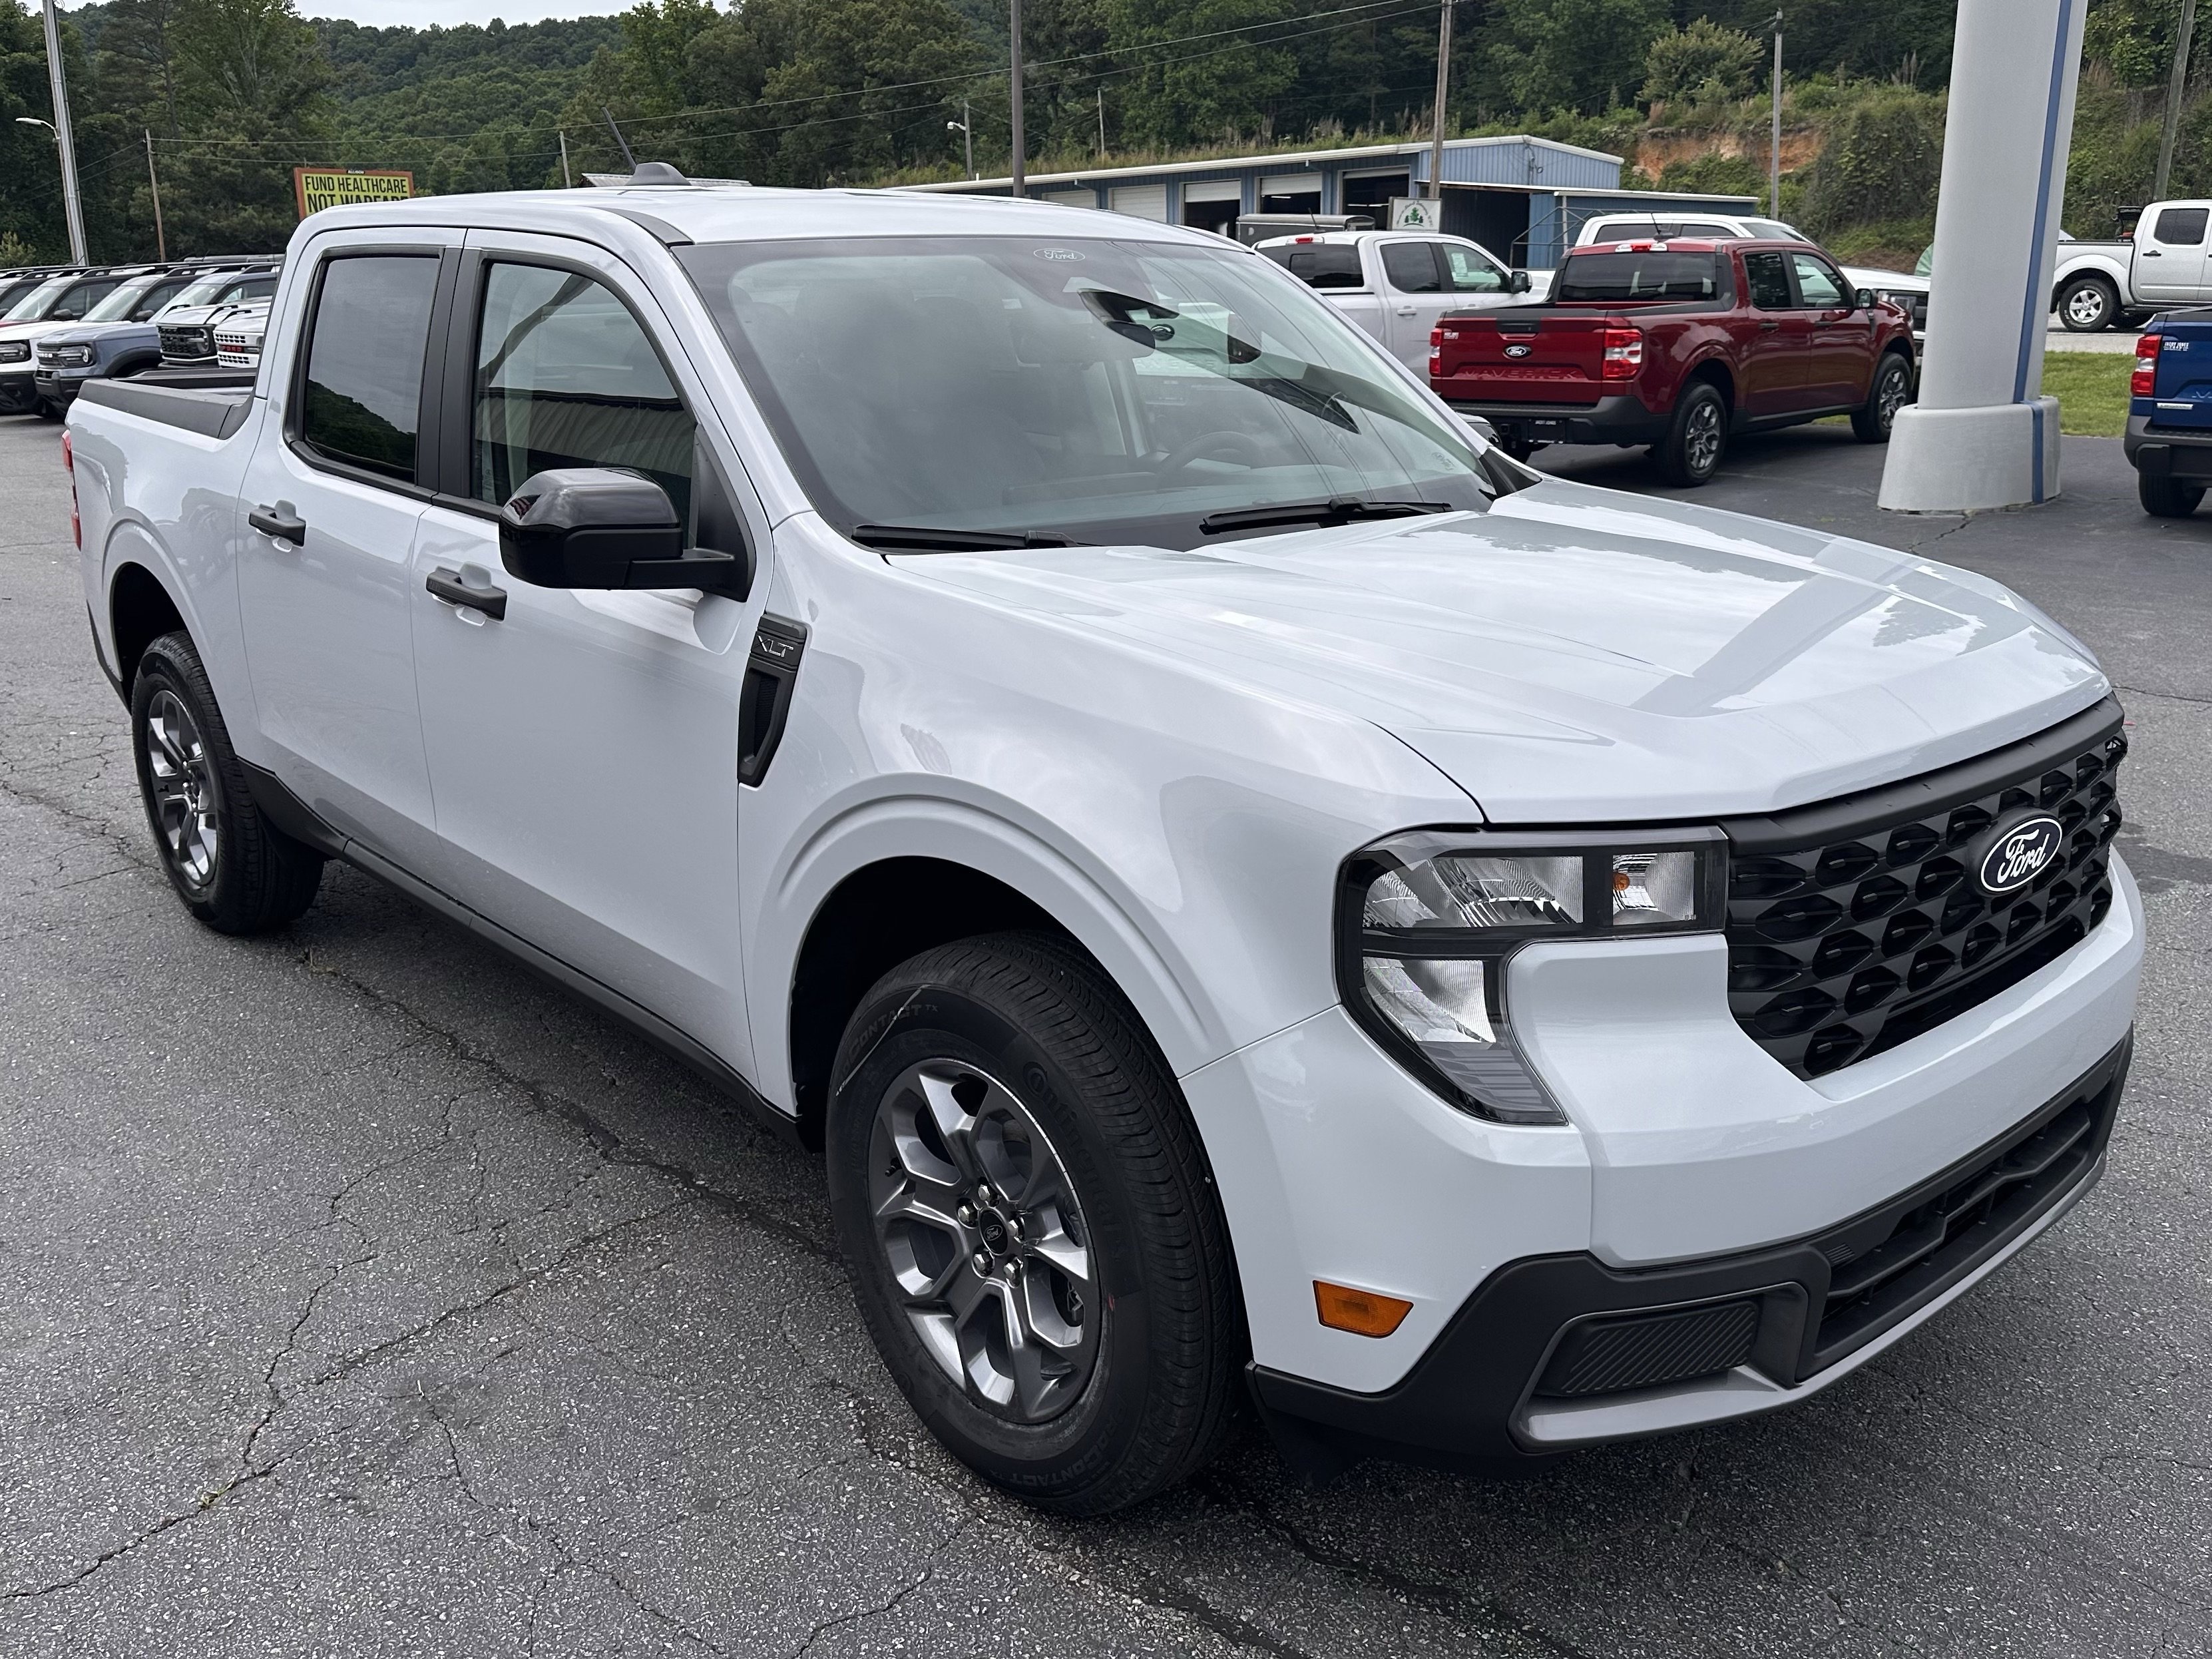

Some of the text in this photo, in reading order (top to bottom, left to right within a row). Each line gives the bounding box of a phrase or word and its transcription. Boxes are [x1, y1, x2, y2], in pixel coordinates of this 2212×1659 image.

[305, 176, 407, 193] FUND HEALTHCARE
[307, 193, 335, 212] NOT
[1043, 250, 1077, 260] Ford
[755, 635, 794, 658] XLT
[1997, 829, 2050, 883] Ford
